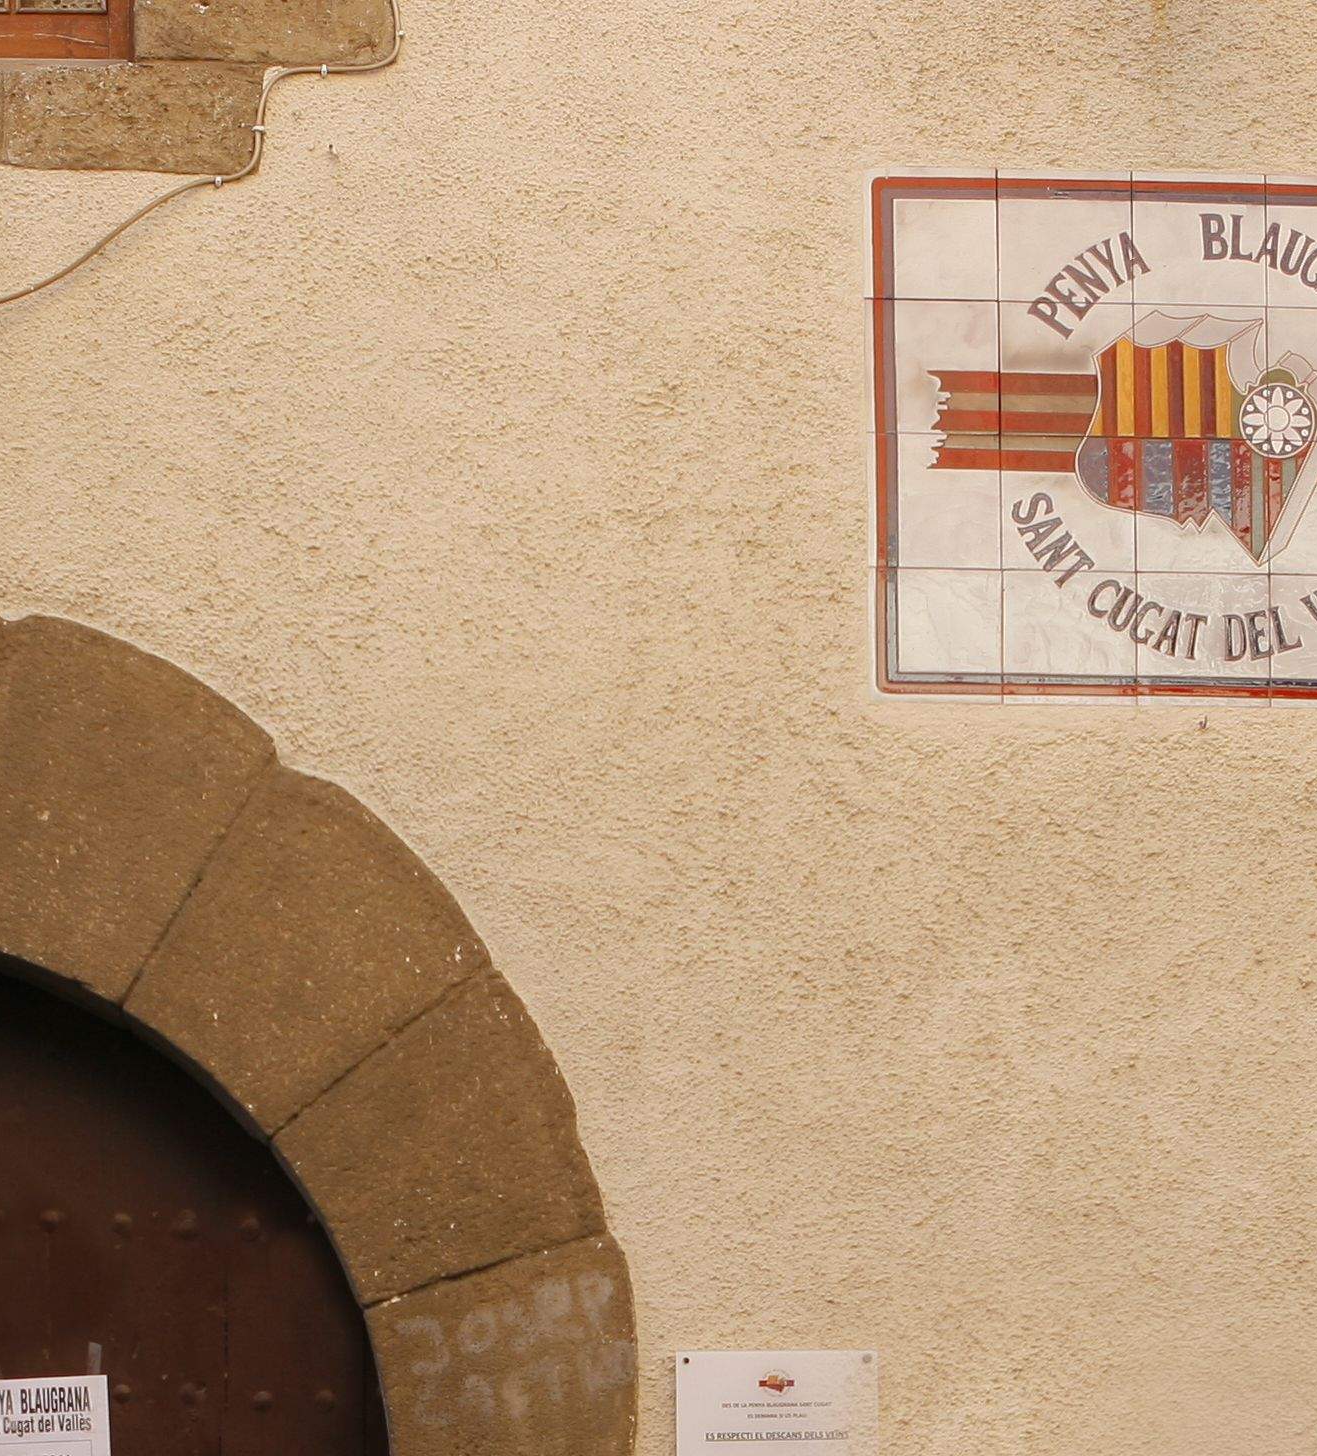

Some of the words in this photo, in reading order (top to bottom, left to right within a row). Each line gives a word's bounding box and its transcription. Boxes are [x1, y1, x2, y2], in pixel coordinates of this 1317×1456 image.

[1027, 231, 1151, 340] PENYA
[1012, 491, 1094, 588] SANT
[1088, 579, 1208, 661] CUGAT
[1223, 609, 1302, 662] DEL
[20, 1386, 91, 1414] BLAUGRANA
[3, 1416, 35, 1438] Cugat
[38, 1414, 55, 1433] del
[59, 1413, 92, 1432] Vallès
[717, 1432, 753, 1440] RESPECTI
[766, 1431, 802, 1440] DESCANS
[804, 1431, 822, 1440] DELS
